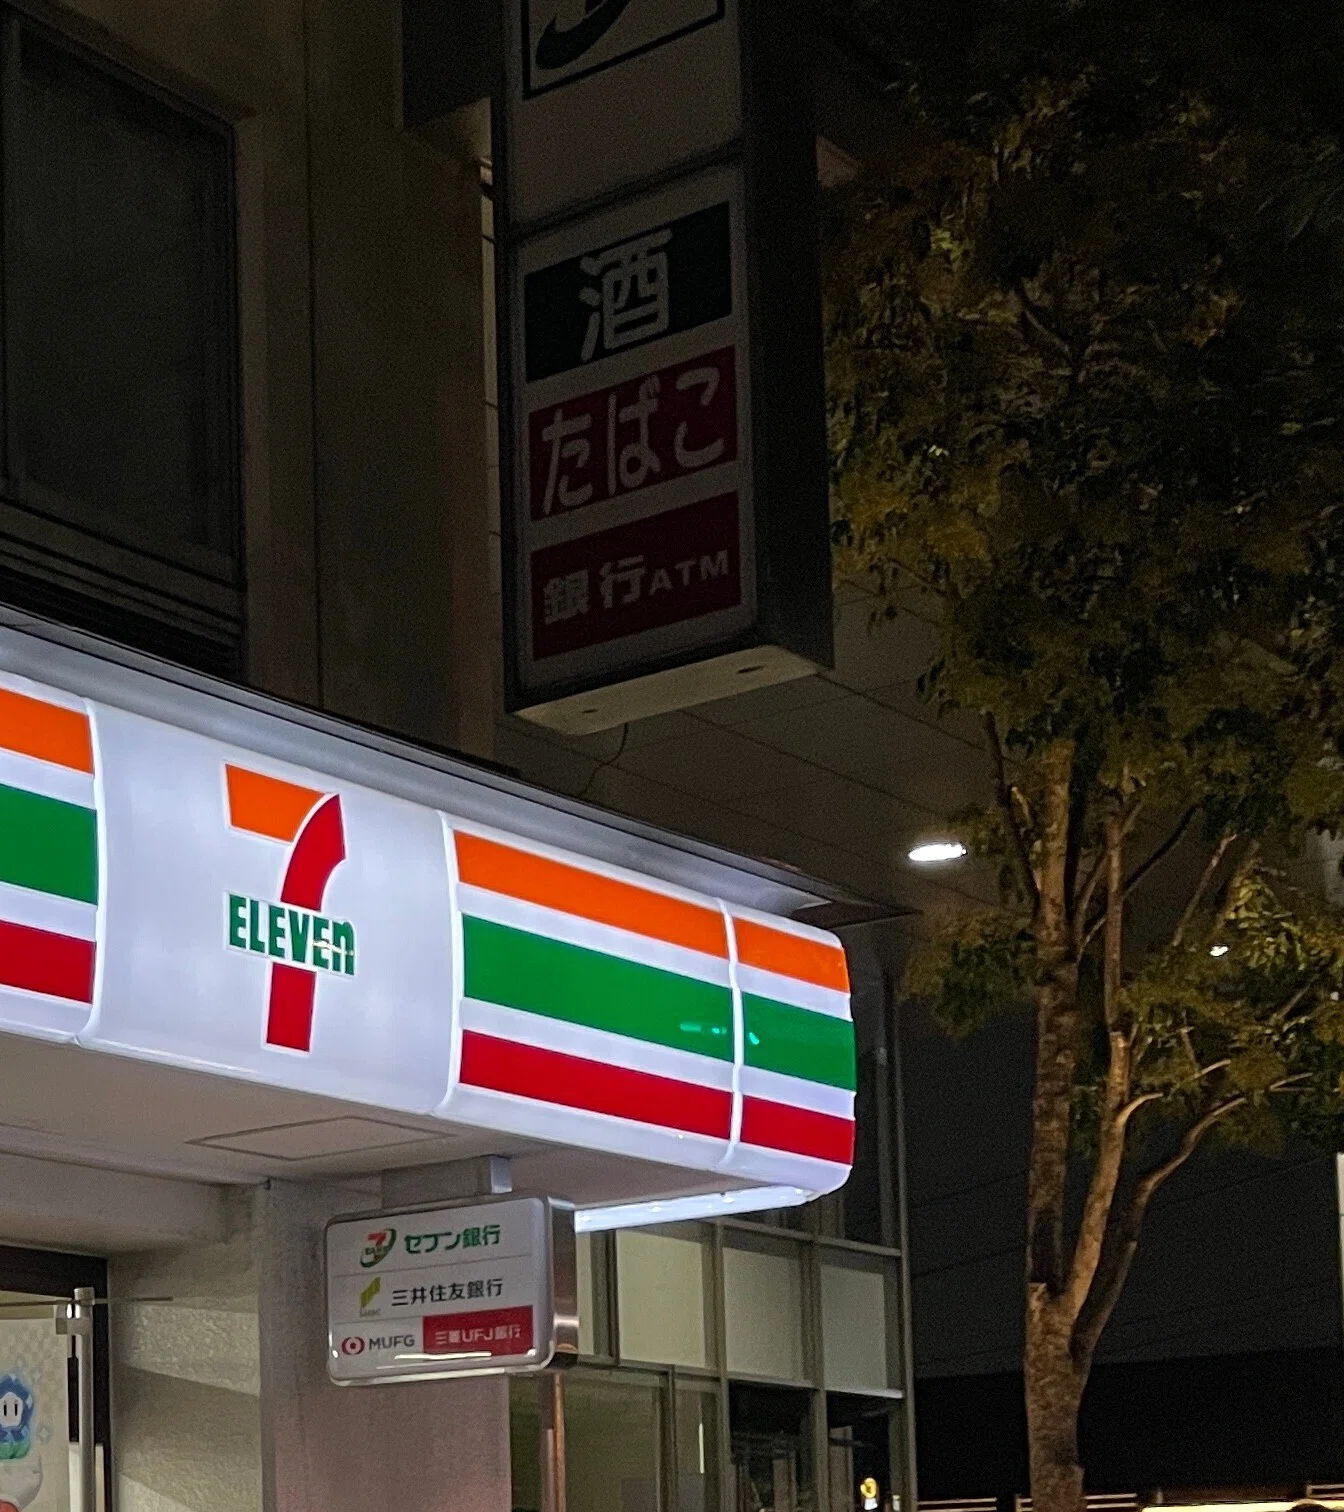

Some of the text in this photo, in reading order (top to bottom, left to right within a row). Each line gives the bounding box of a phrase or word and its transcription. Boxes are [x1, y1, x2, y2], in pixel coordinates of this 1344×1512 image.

[579, 228, 673, 364] 酒
[542, 367, 724, 514] たばこ
[403, 1224, 501, 1255] セブン銀行
[391, 1278, 504, 1307] 三井住友銀行
[368, 1334, 415, 1350] MUFG
